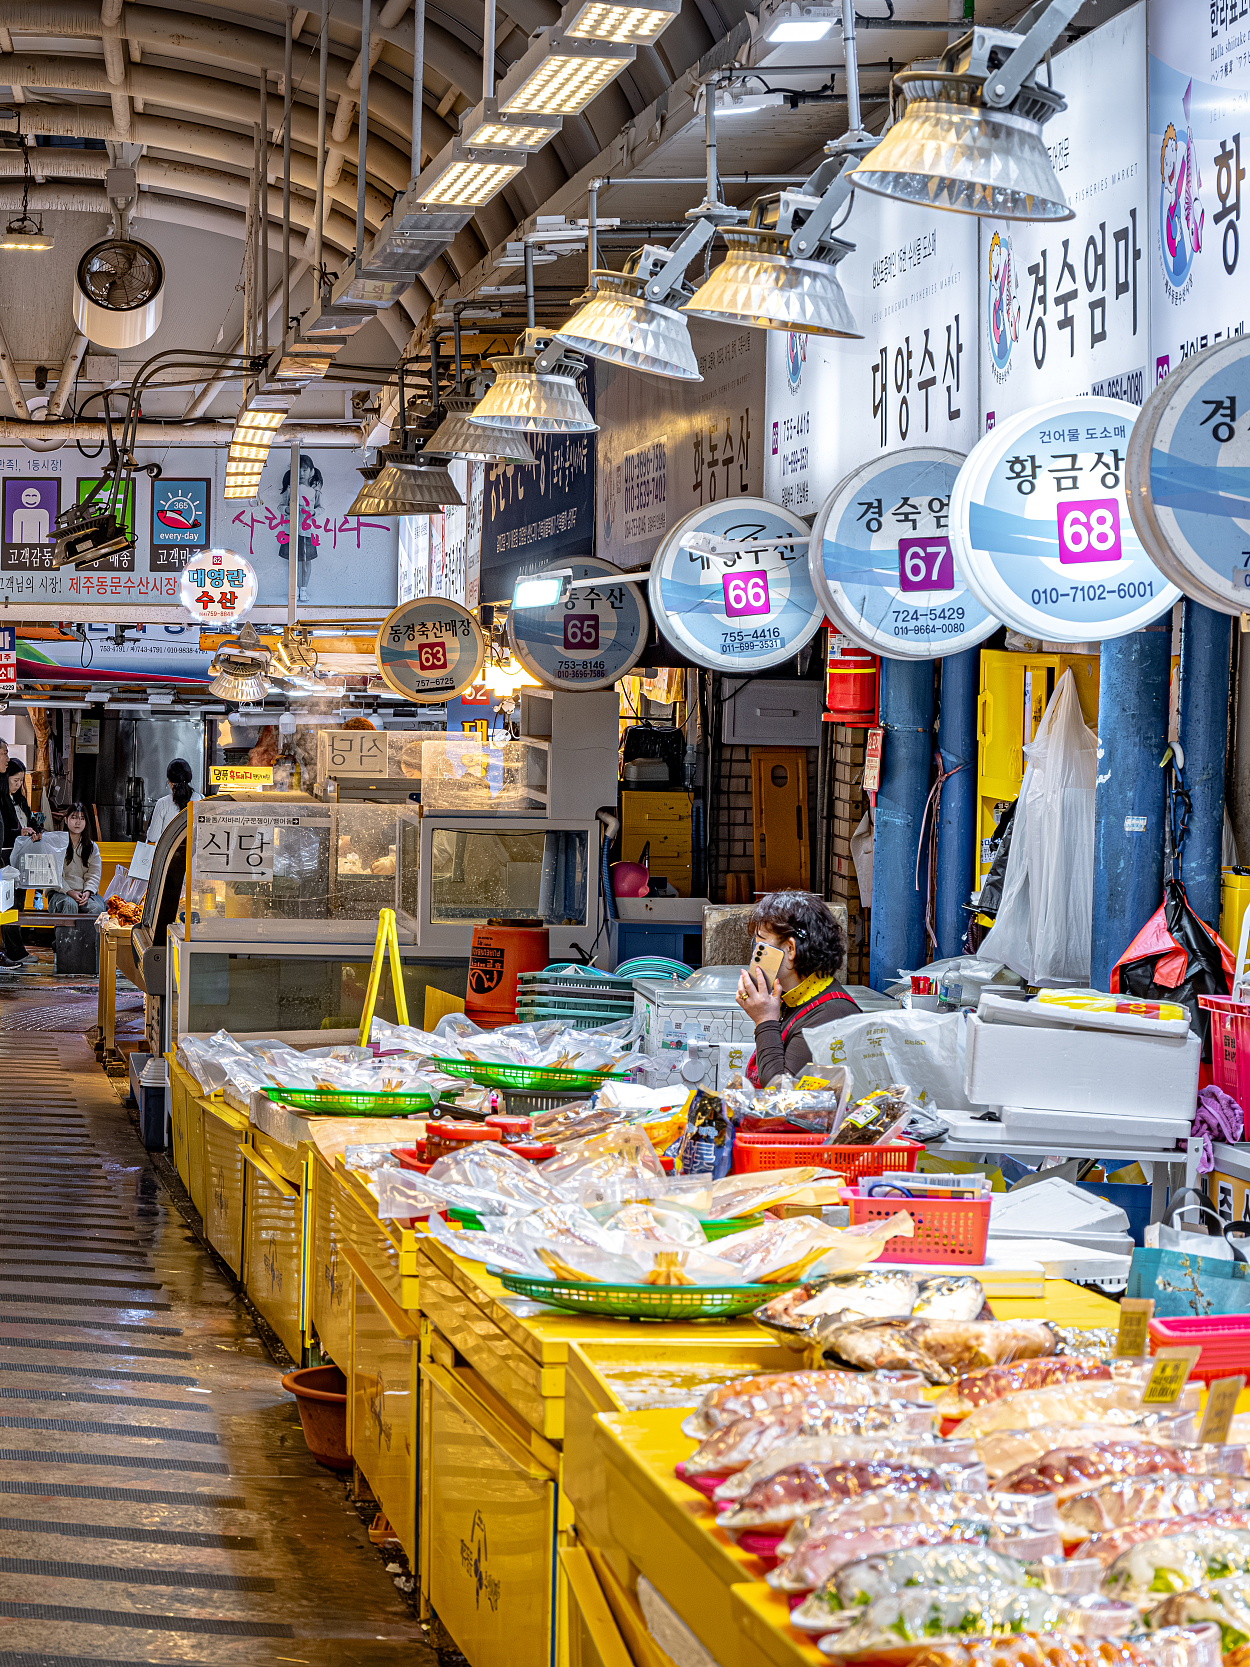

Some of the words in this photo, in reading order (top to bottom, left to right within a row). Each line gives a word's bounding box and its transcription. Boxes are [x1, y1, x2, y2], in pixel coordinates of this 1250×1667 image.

[1210, 43, 1223, 63] Halla
[1075, 176, 1108, 204] FISHERIES
[1111, 163, 1139, 185] MARKET
[1026, 207, 1142, 370] 경숙엄마
[871, 313, 963, 448] 대양수산
[783, 411, 810, 442] 755-4416
[1200, 396, 1237, 443] 경
[1039, 429, 1081, 444] 건어물
[1085, 425, 1127, 441] 도소매
[27, 459, 62, 472] 1등시장!
[173, 501, 189, 510] 365
[232, 495, 392, 555] 사랑합니다
[1062, 507, 1117, 553] 68
[159, 532, 199, 542] every-day
[7, 547, 54, 567] 고객감동
[904, 545, 948, 582] 67
[38, 576, 62, 594] 시장!
[68, 576, 178, 595] 제주동문수산시장
[188, 568, 247, 589] 대영란
[195, 591, 238, 610] 수산
[728, 577, 766, 609] 66
[1031, 580, 1155, 606] 010-7102-6001
[892, 607, 965, 624] 724-5429
[389, 618, 472, 644] 동경축산매장
[567, 619, 596, 643] 65
[721, 627, 781, 642] 755-4416
[100, 645, 125, 653] 753-4791
[721, 639, 779, 652] 011-699-3531
[420, 646, 445, 667] 63
[558, 661, 605, 670] 753-8146
[415, 677, 455, 688] 757-6725
[557, 669, 605, 679] 010-3696-7586
[213, 768, 229, 781] 명품
[229, 770, 253, 780] 흑돼지
[202, 830, 271, 867] 식당
